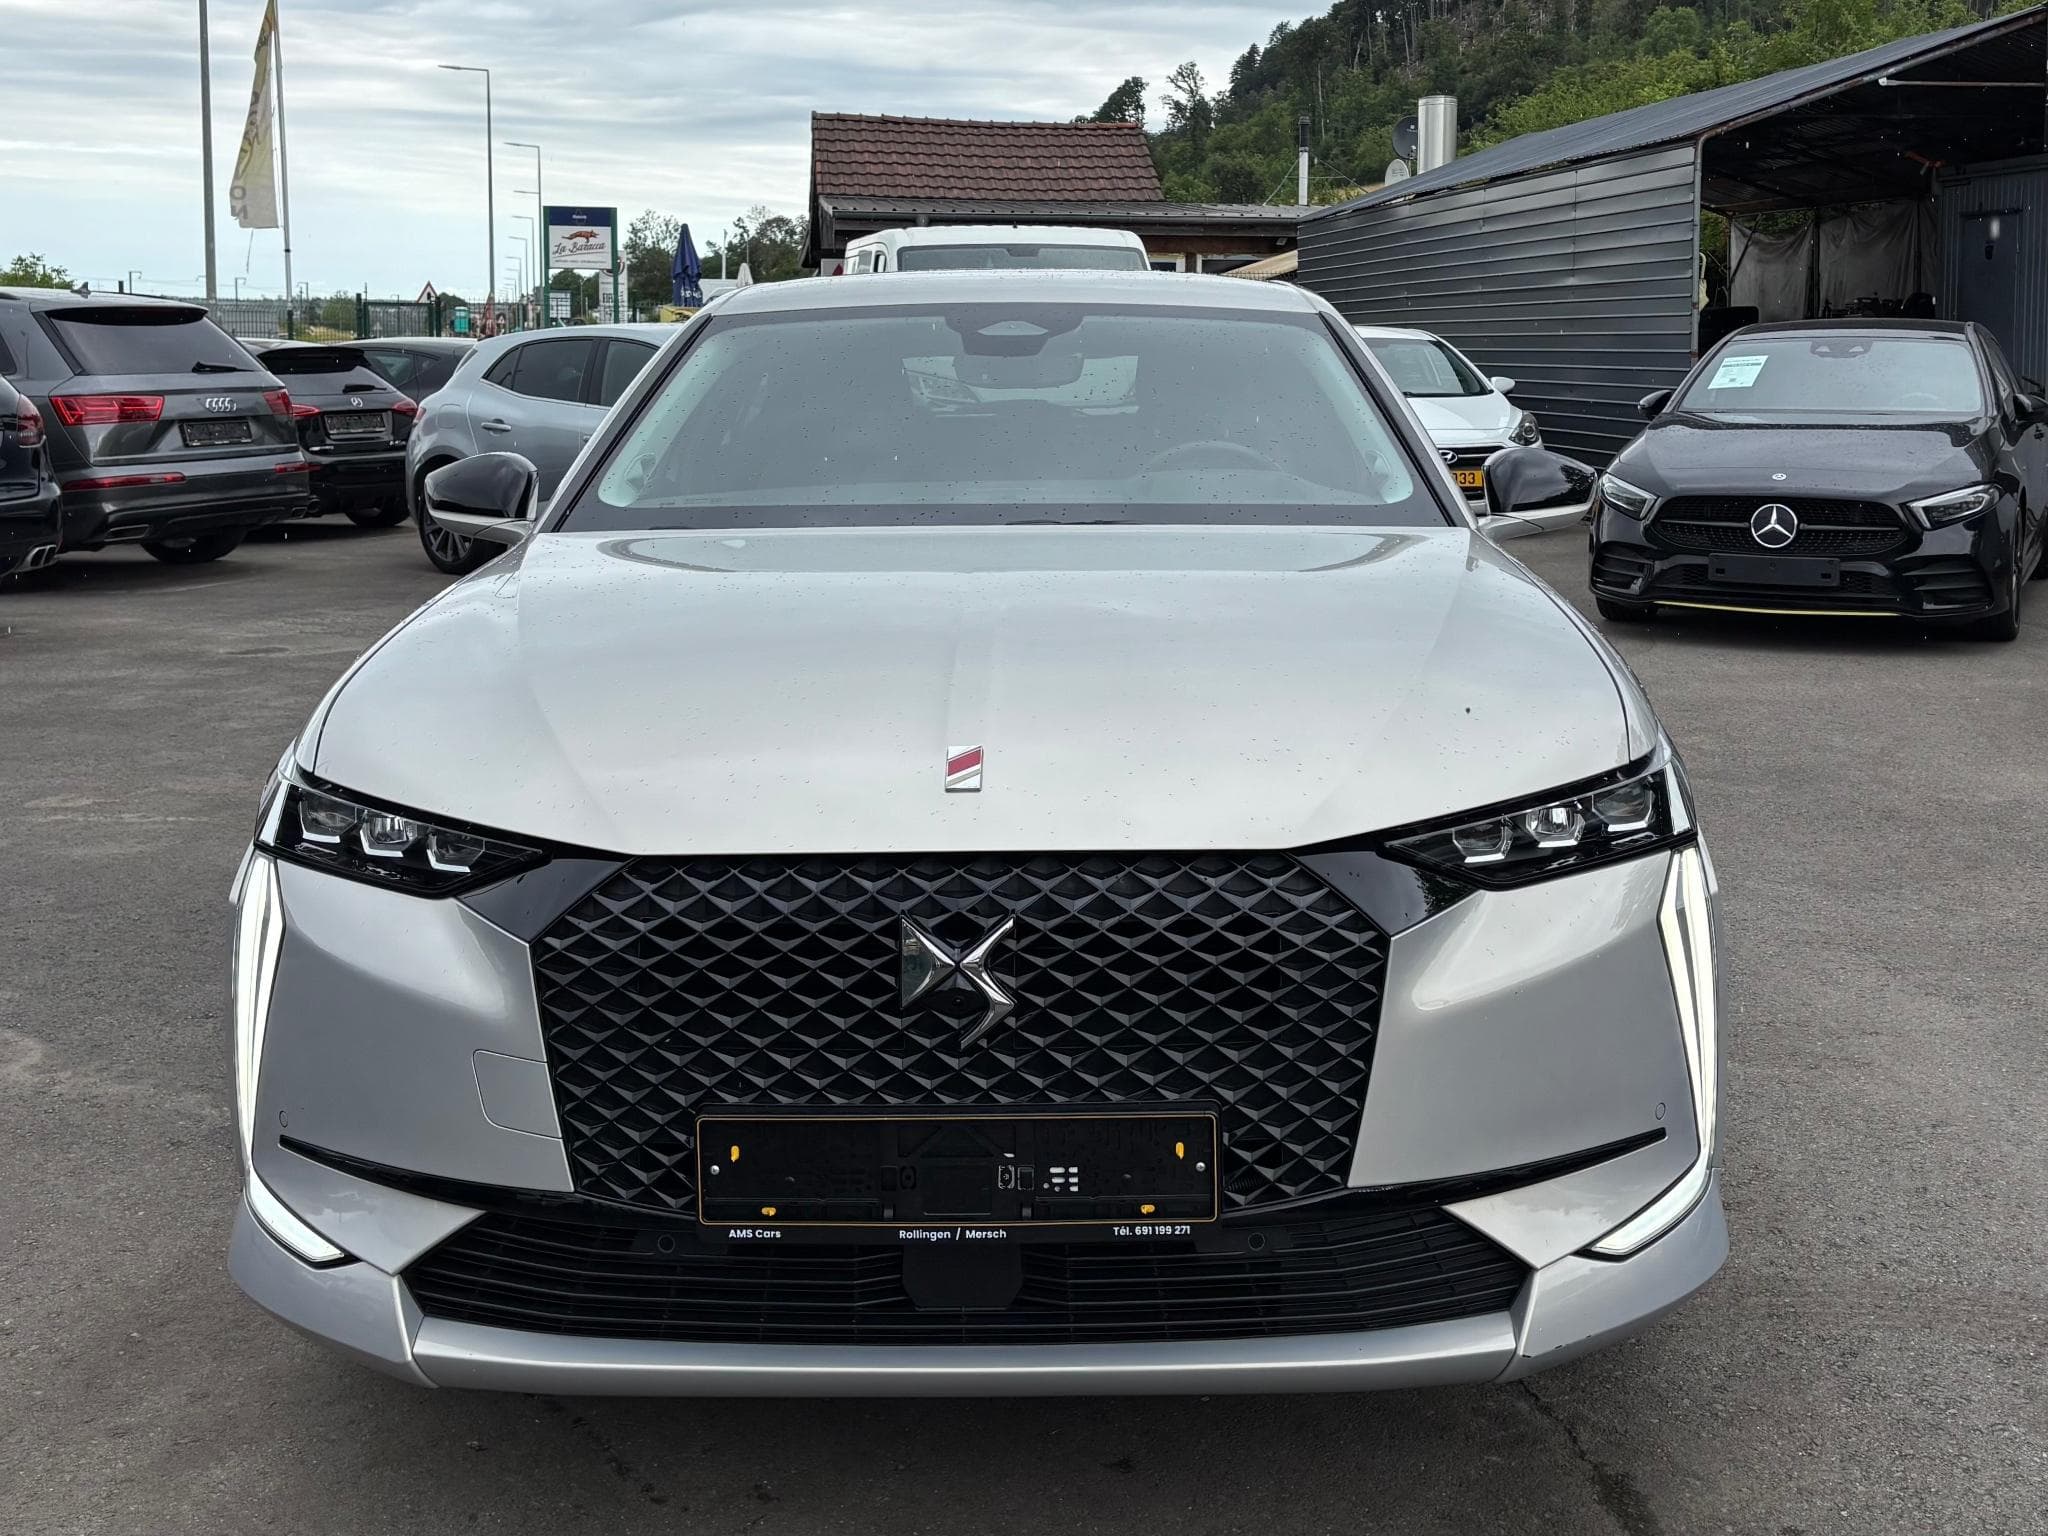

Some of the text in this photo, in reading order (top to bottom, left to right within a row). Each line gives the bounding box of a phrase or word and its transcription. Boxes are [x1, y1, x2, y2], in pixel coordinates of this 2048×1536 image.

[552, 242, 567, 255] La
[728, 1229, 781, 1238] AMS Cars
[899, 1229, 951, 1241] Rollingen
[965, 1229, 1007, 1239] Mersch
[1112, 1225, 1191, 1236] Tél. 691 199 271
